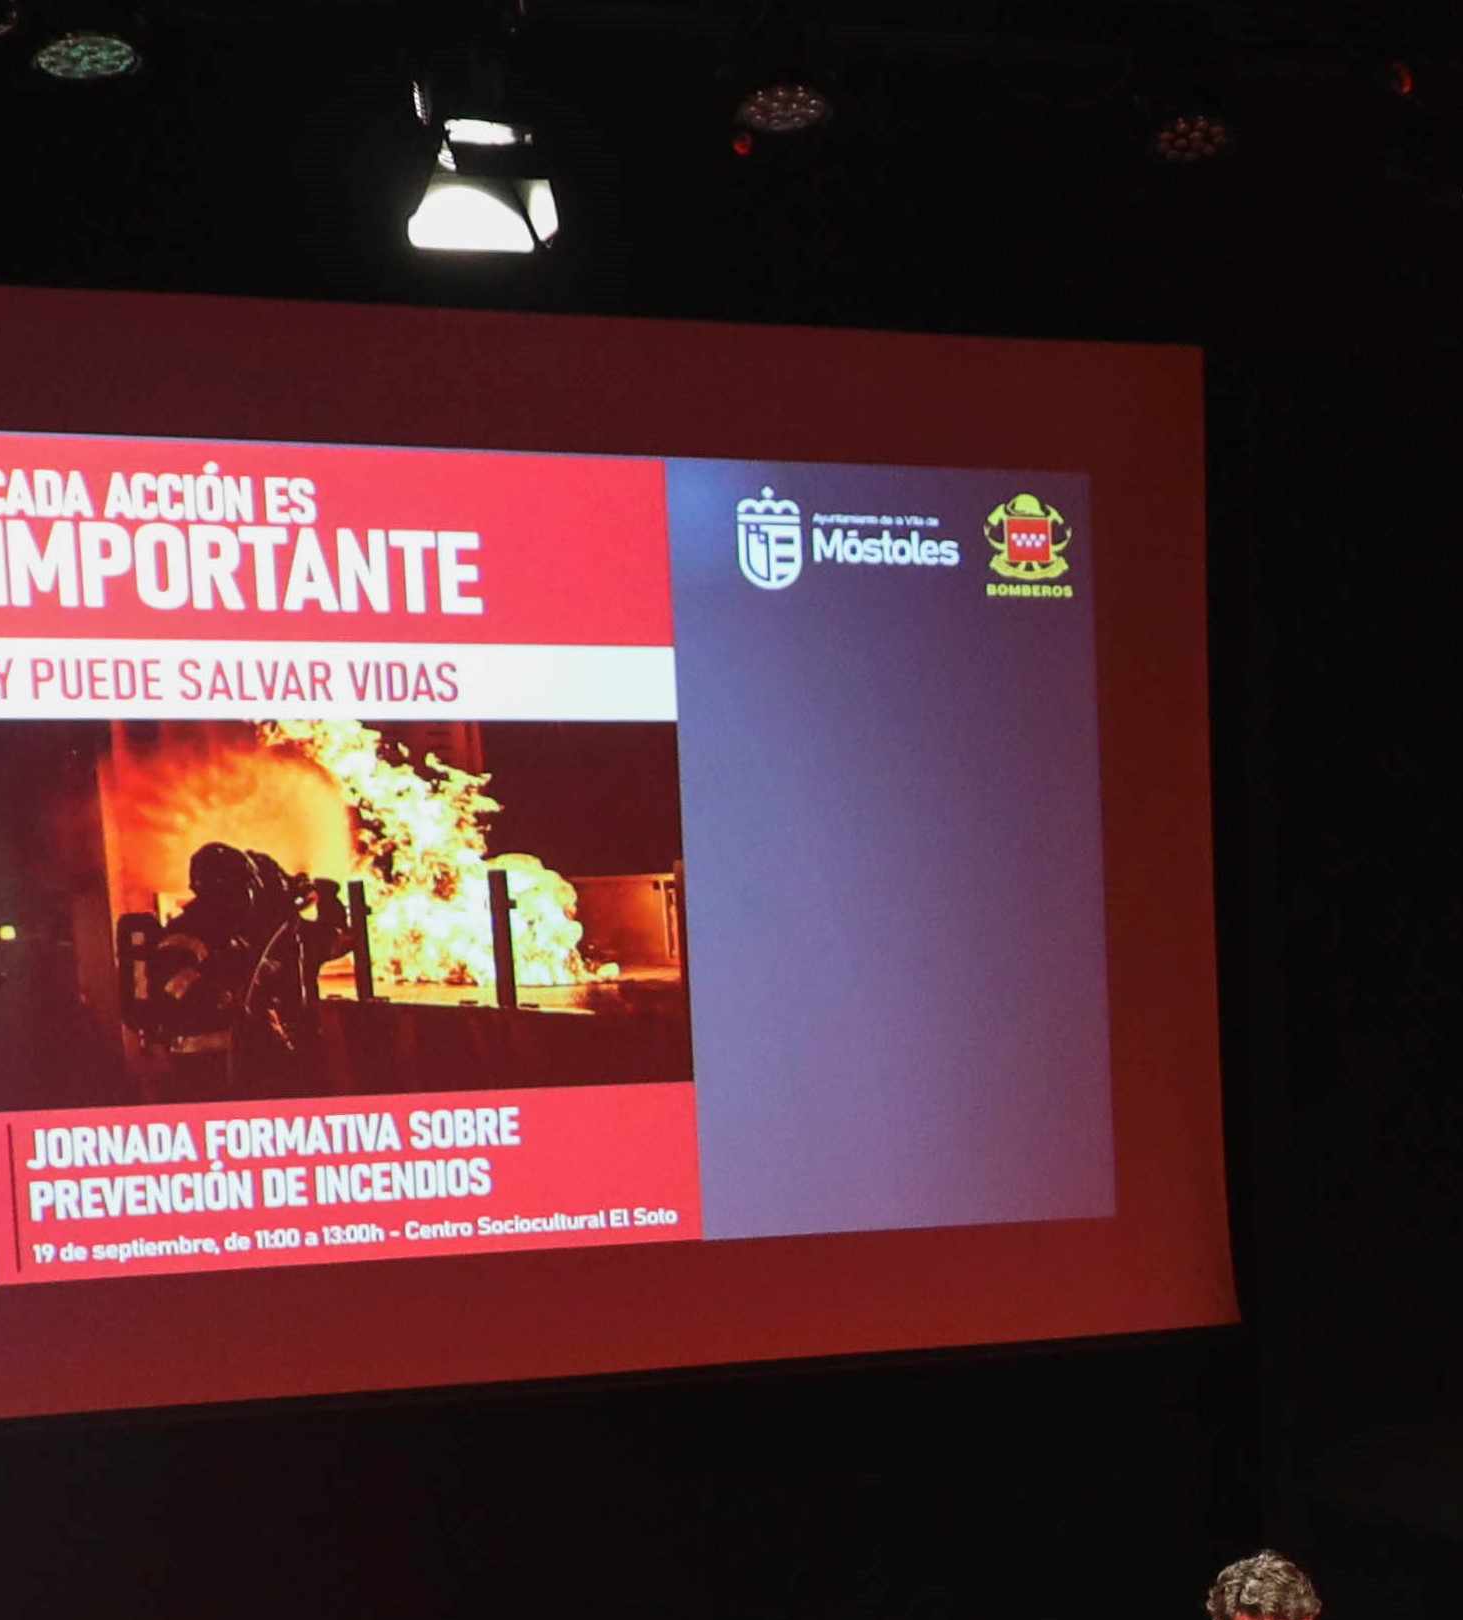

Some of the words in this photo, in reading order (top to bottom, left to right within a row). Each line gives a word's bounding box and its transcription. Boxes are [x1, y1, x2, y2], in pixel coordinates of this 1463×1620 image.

[104, 460, 253, 523] ACCIÓN
[264, 476, 317, 525] ES
[812, 527, 961, 567] Móstoles
[986, 582, 1074, 599] BOMBEROS
[30, 657, 163, 702] PUEDE
[178, 658, 334, 703] SALVAR
[348, 660, 460, 704] VIDAS
[26, 1119, 198, 1171] JORNADA
[206, 1112, 402, 1161] FORMATIVA
[410, 1105, 521, 1150] SOBRE
[28, 1161, 255, 1222] PREVENCIÓN
[263, 1170, 308, 1210] DE
[316, 1158, 493, 1206] INCENDIOS
[32, 1242, 56, 1265] 19
[60, 1240, 88, 1262] de
[91, 1231, 221, 1265] septiembre,
[223, 1229, 252, 1252] de
[255, 1226, 302, 1249] 11:00
[304, 1230, 319, 1247] a
[321, 1221, 386, 1247] 13:00h
[404, 1216, 474, 1241] Centro
[477, 1207, 606, 1237] Sociocultural
[609, 1206, 631, 1228] El
[633, 1204, 679, 1226] Soto
